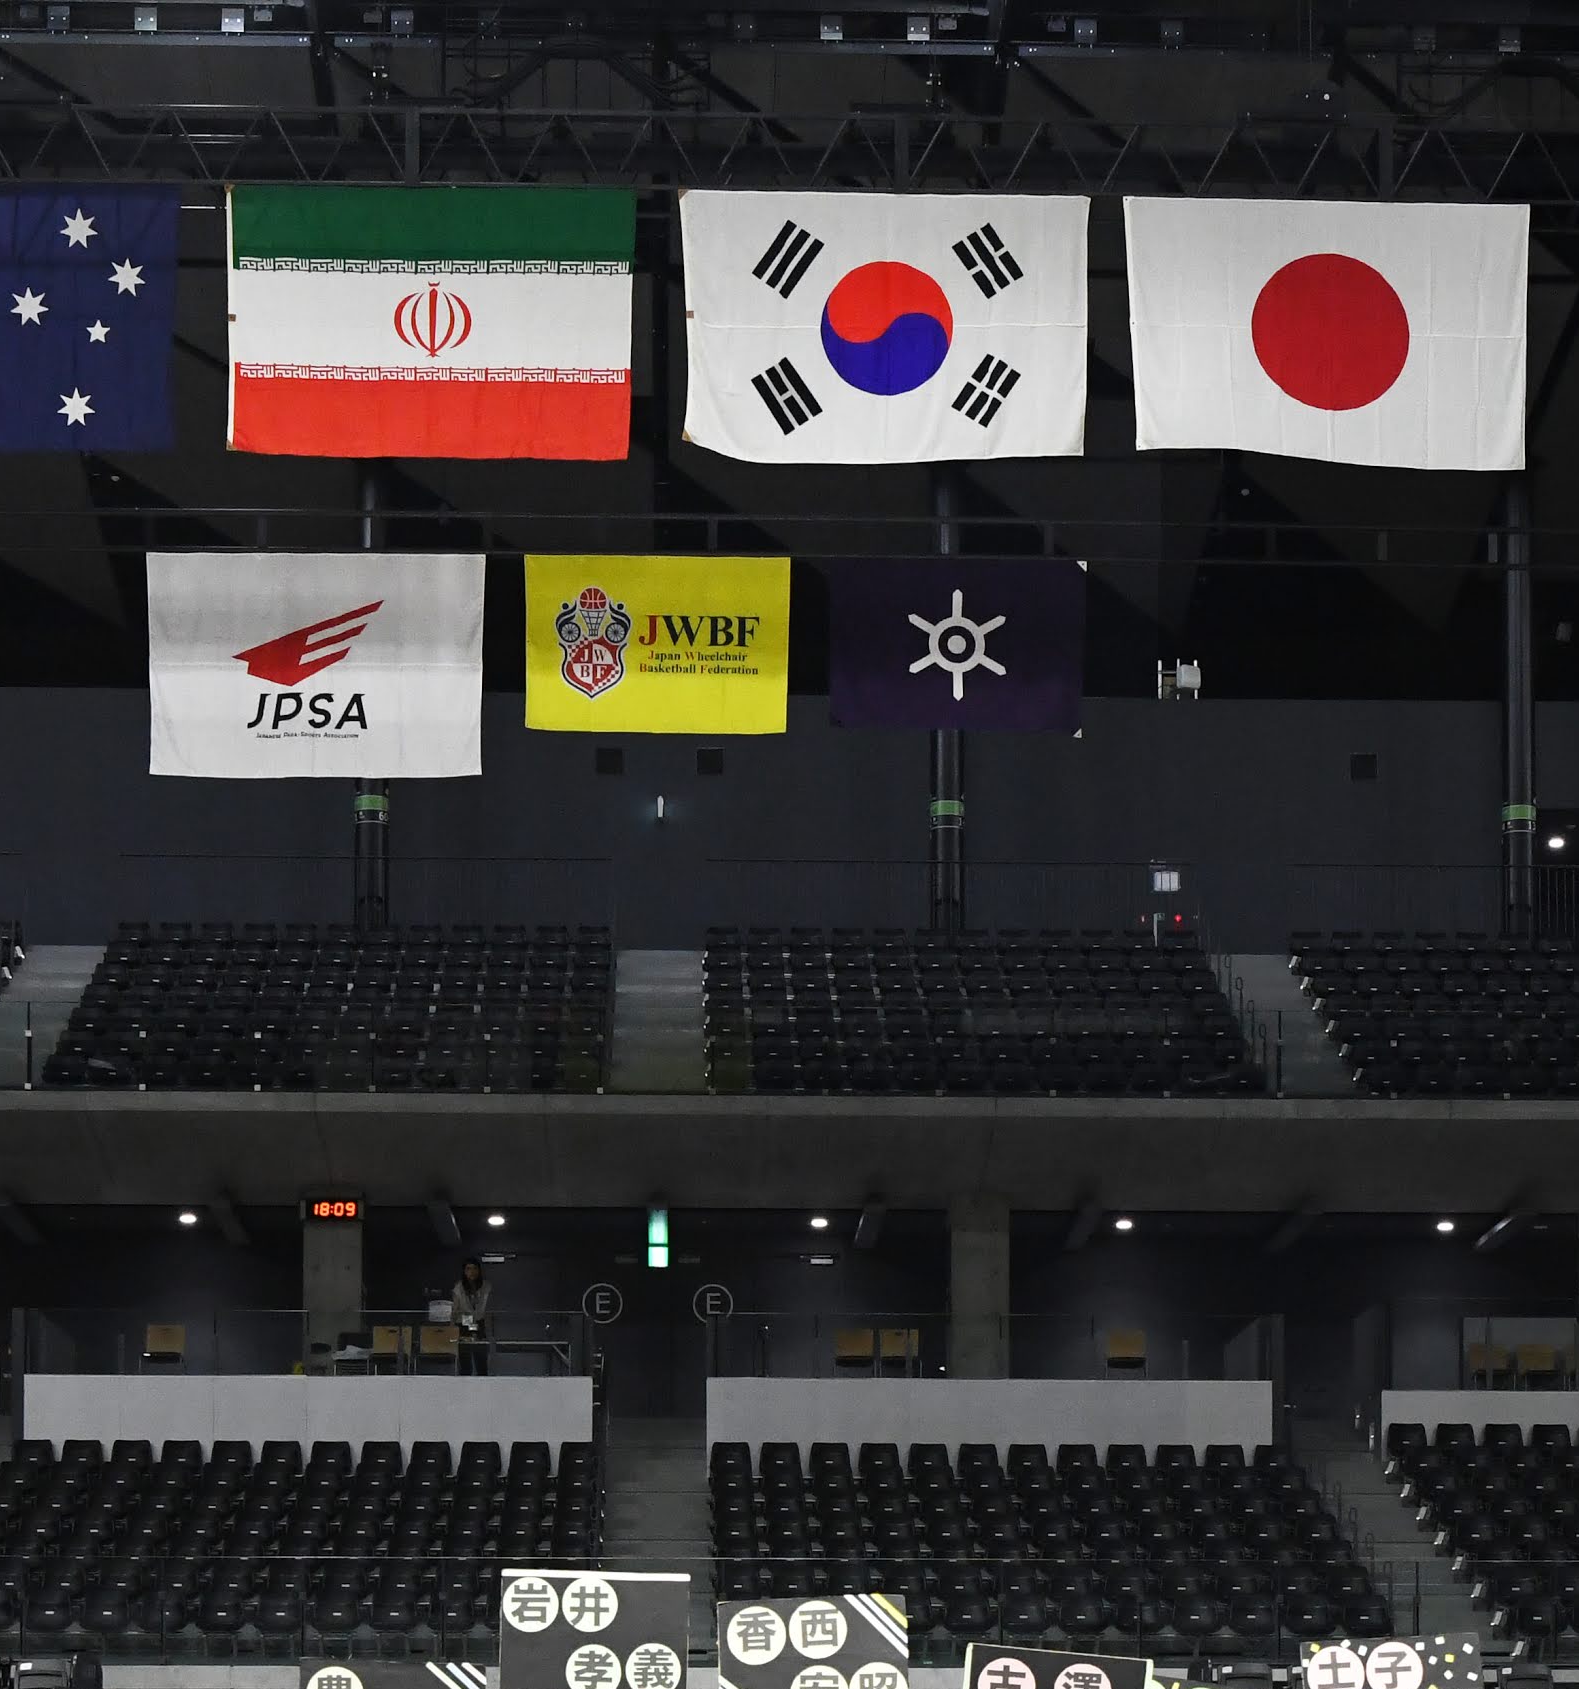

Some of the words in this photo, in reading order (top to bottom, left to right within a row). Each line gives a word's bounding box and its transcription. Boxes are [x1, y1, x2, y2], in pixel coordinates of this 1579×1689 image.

[638, 615, 760, 647] JWBF
[639, 664, 696, 674] Basketball
[700, 665, 759, 675] Federation
[648, 650, 681, 662] Japan
[684, 651, 748, 662] Wheelchair
[247, 692, 367, 729] JPSA
[314, 1202, 356, 1217] 18:09
[511, 1582, 610, 1626] 岩井
[736, 1609, 839, 1657] 香西
[1318, 1651, 1412, 1689] 土子
